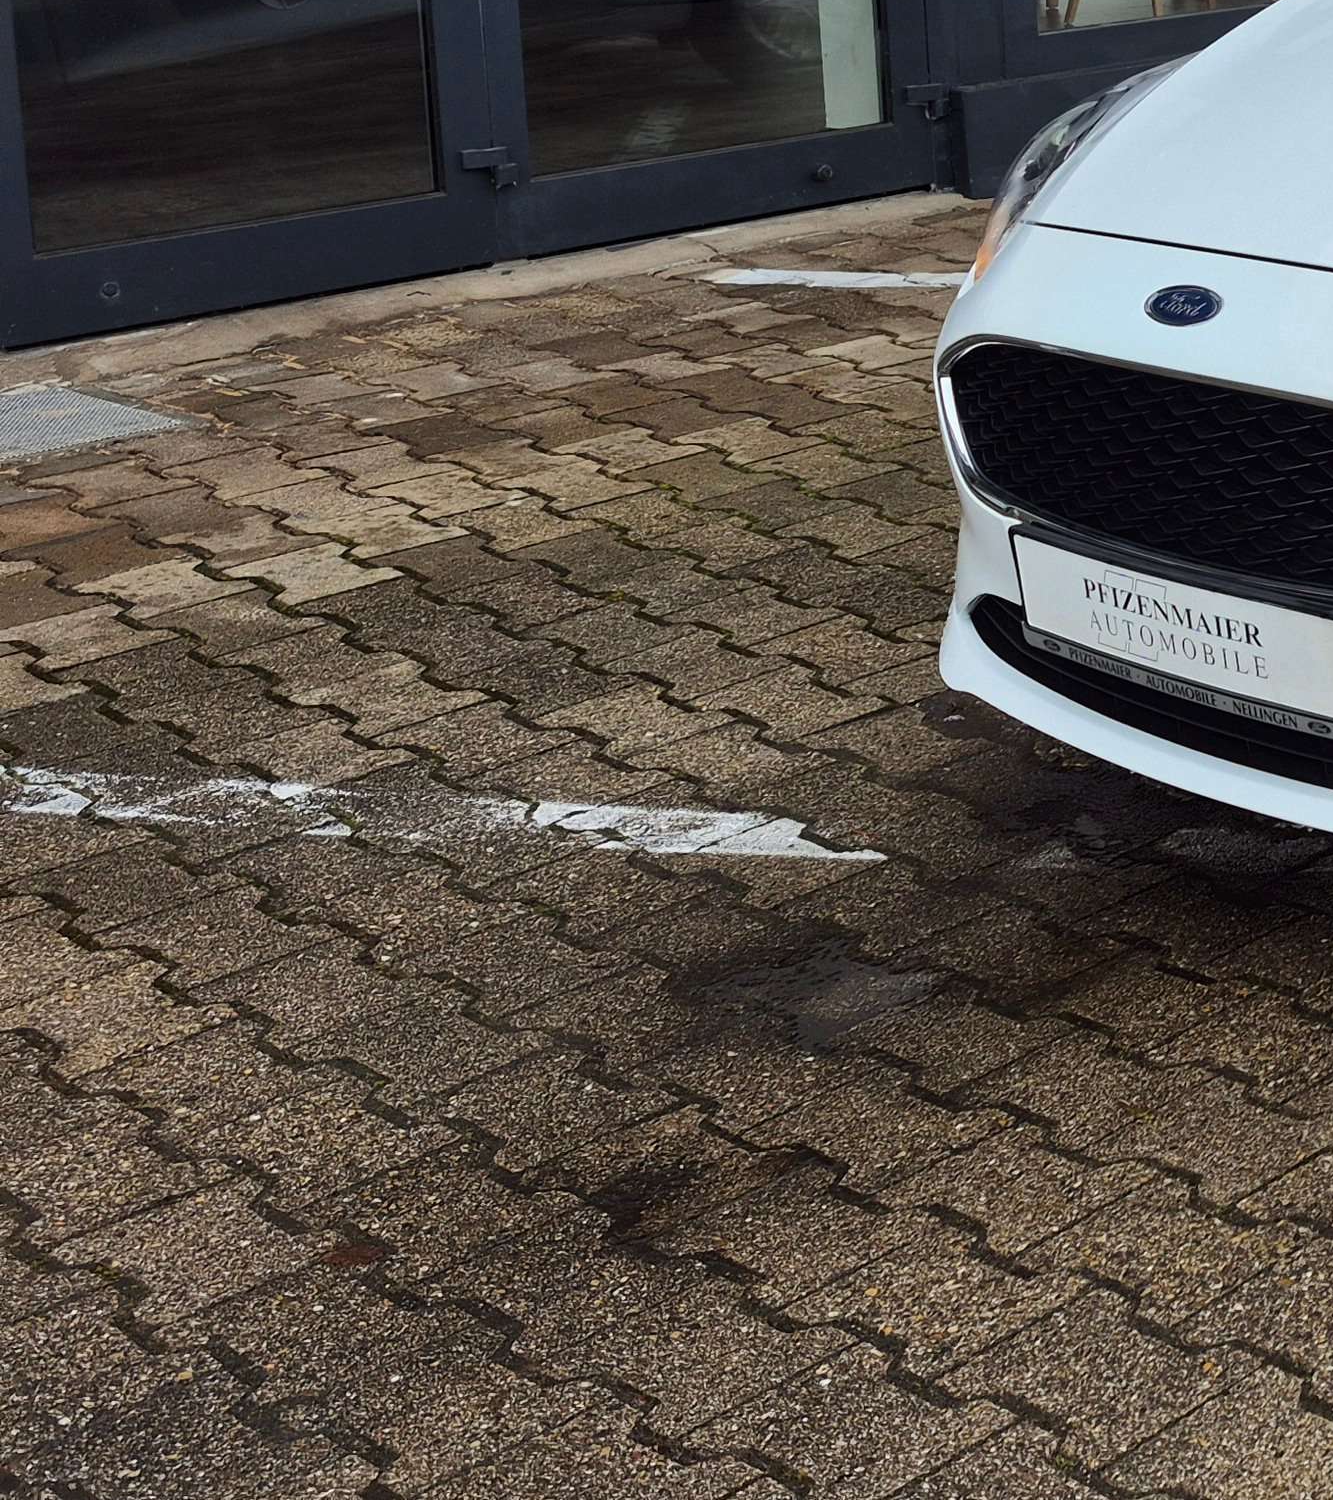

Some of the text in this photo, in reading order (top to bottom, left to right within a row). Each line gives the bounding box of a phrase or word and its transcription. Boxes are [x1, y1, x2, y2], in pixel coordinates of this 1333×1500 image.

[1082, 577, 1263, 648] PFIZENMAIER
[1089, 609, 1270, 680] AUTOMOBILE
[1068, 646, 1132, 680] PFIZENMAIER
[1145, 674, 1217, 707] AUTOMOBILE
[1232, 699, 1298, 729] NELLINGEN
